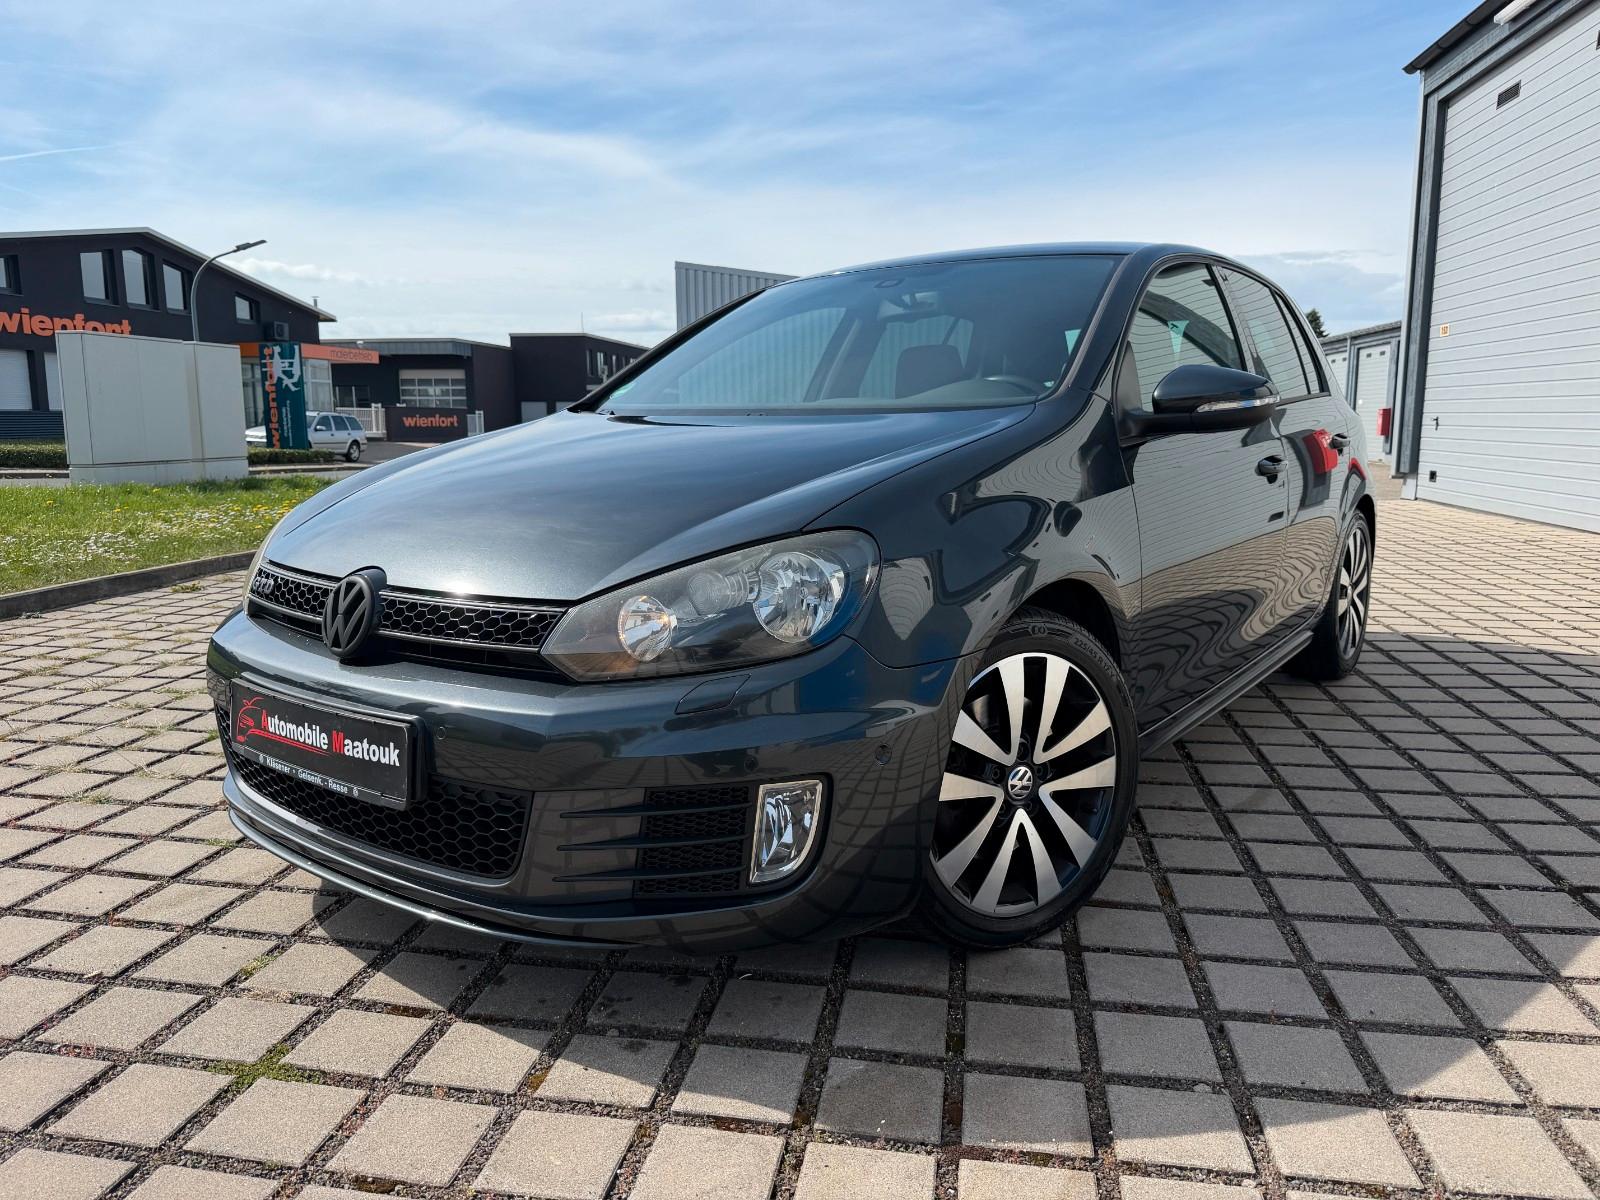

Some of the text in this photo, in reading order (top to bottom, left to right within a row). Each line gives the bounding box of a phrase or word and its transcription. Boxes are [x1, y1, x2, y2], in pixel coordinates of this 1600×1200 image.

[403, 414, 458, 427] wienfort
[261, 709, 400, 767] Automobile Maatouk
[328, 778, 348, 794] Resse
